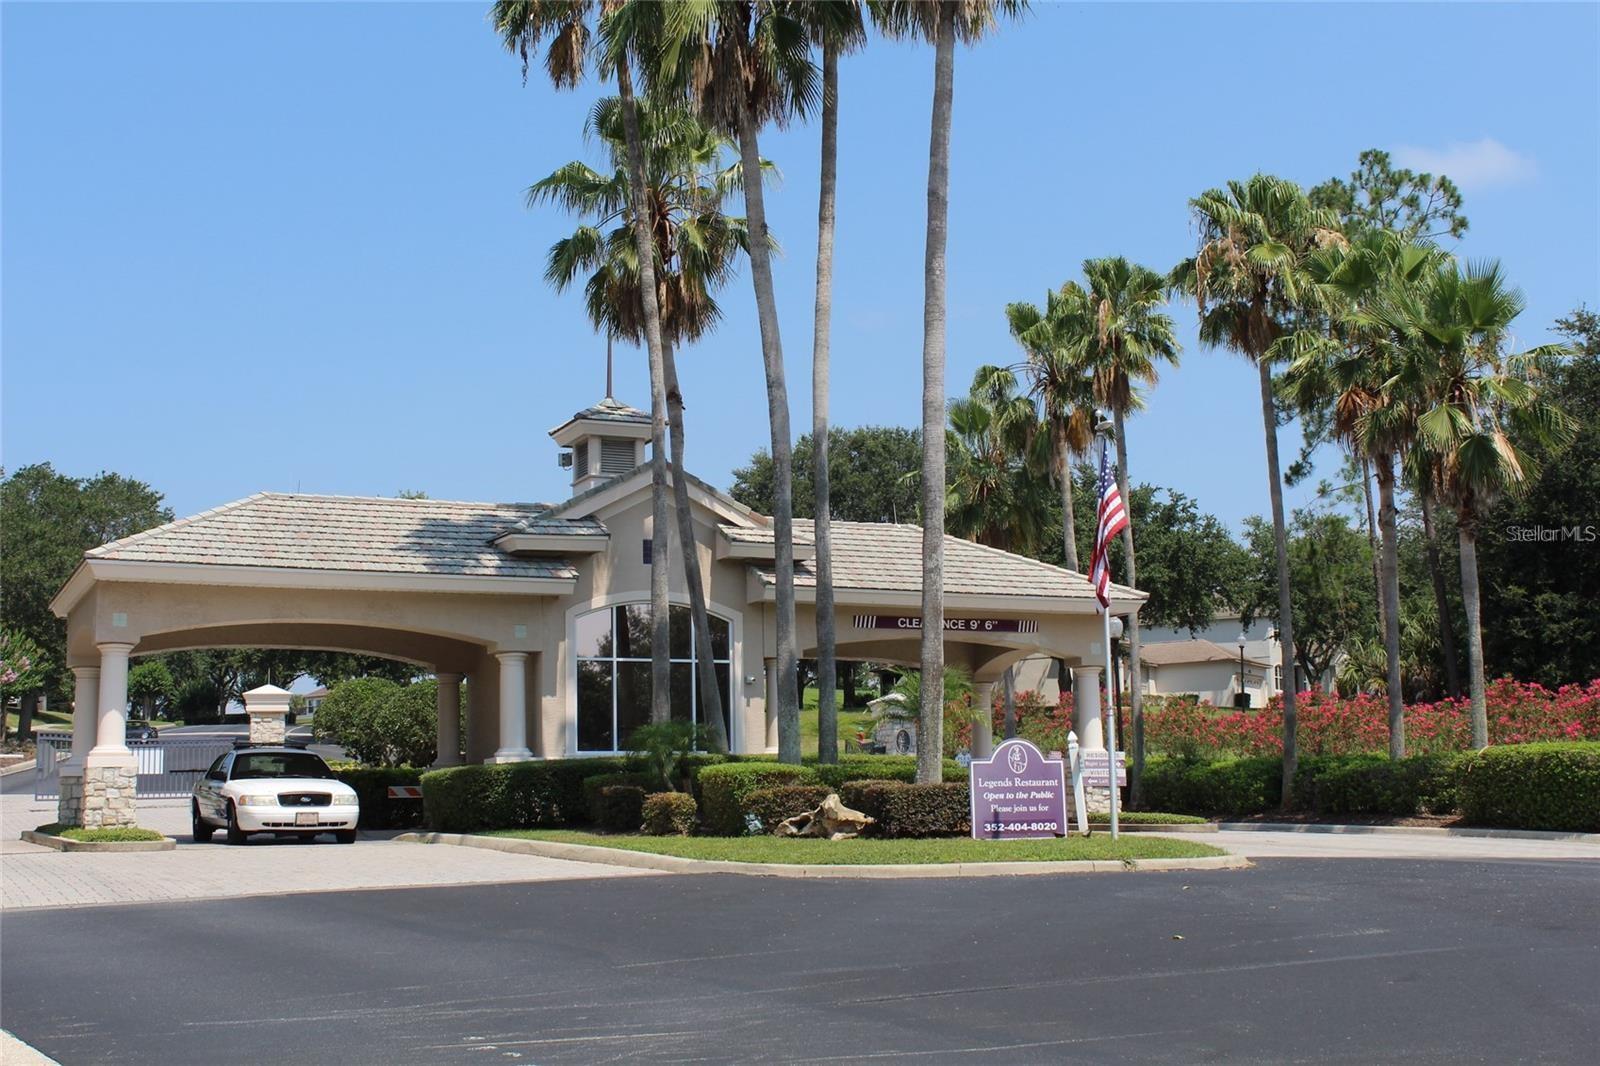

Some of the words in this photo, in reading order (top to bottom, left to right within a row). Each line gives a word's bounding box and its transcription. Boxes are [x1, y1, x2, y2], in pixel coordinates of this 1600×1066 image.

[897, 617, 966, 630] CLENCE
[978, 778, 1012, 789] Legends
[1014, 778, 1059, 787] Restaurant
[983, 792, 1005, 802] Open
[1006, 792, 1015, 800] to
[1015, 791, 1029, 799] the
[1030, 791, 1055, 799] Public
[990, 804, 1013, 813] Please
[1013, 804, 1028, 814] join
[1038, 803, 1049, 812] for
[983, 822, 1058, 832] 352-404-8020
